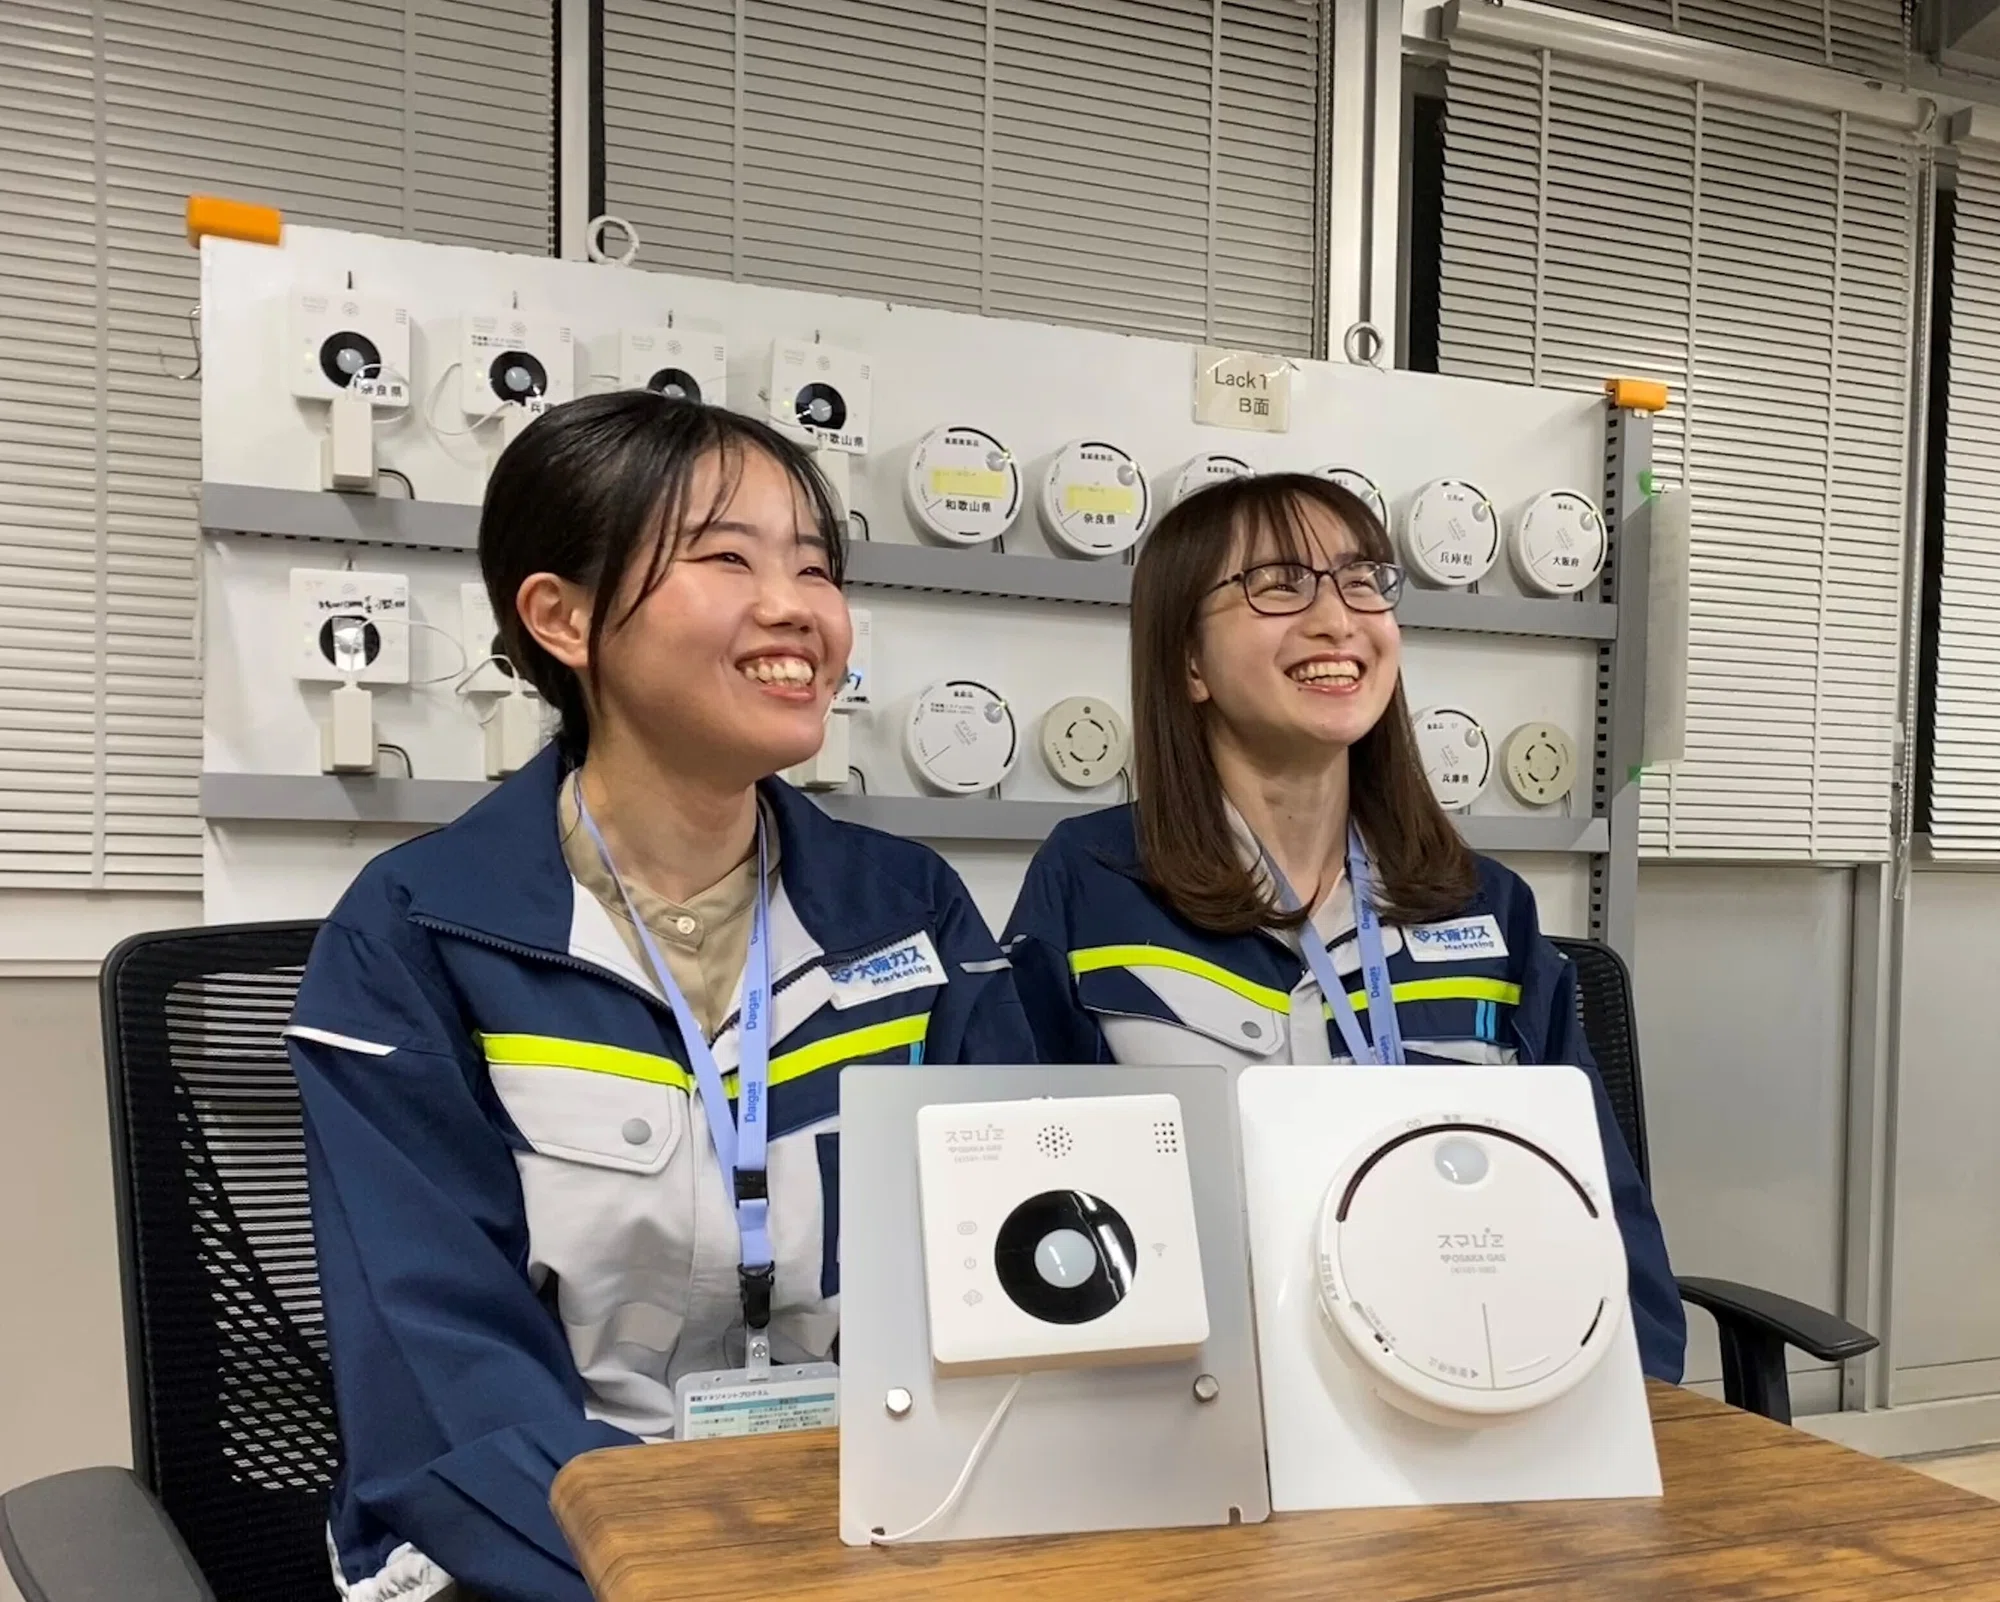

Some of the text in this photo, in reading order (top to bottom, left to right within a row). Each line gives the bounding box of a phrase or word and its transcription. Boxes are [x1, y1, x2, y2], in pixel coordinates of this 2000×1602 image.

[1239, 397, 1270, 416] B面
[944, 499, 993, 513] 和歌山県
[1083, 514, 1116, 525] 奈良県
[1440, 553, 1473, 566] 兵庫県
[1552, 556, 1580, 568] 大阪府
[1442, 773, 1470, 784] 兵庫県
[1433, 925, 1491, 942] 大阪ガス
[1443, 940, 1495, 952] Marketing
[854, 945, 927, 980] 大阪ガス
[871, 963, 933, 987] Marketing
[745, 989, 760, 1031] Daigas
[744, 1081, 760, 1124] Daigas
[1451, 1253, 1507, 1263] OSAKA GAS
